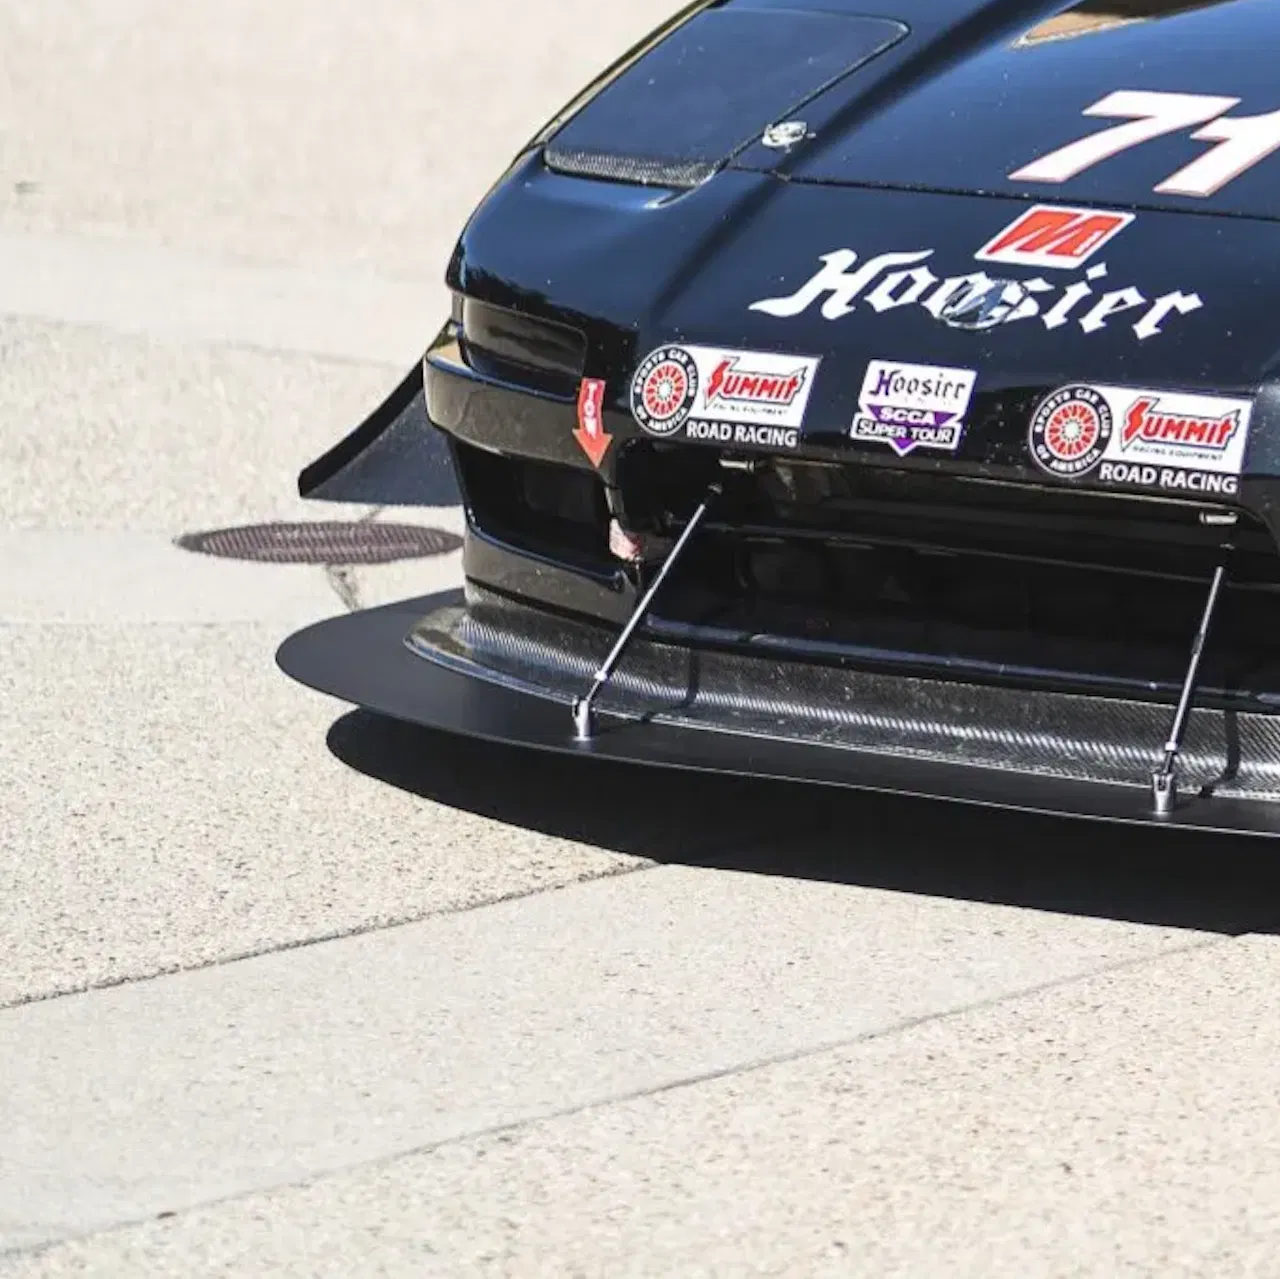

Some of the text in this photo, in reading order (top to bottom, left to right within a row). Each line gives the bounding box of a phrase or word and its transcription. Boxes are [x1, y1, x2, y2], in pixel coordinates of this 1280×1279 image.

[748, 248, 1204, 340] Hoosier
[634, 350, 666, 394] SPORTS
[668, 349, 688, 364] CAR
[868, 368, 966, 400] Hoosier
[582, 382, 597, 439] TOW
[648, 407, 688, 431] AMERICA
[880, 406, 936, 426] SCCA
[1035, 389, 1110, 438] SPORTS CAR CLUB
[687, 422, 798, 448] ROAD RACING
[859, 420, 953, 443] SUPER TOUR
[1036, 444, 1101, 472] OF AMERICA
[1099, 462, 1238, 494] ROAD RACING
